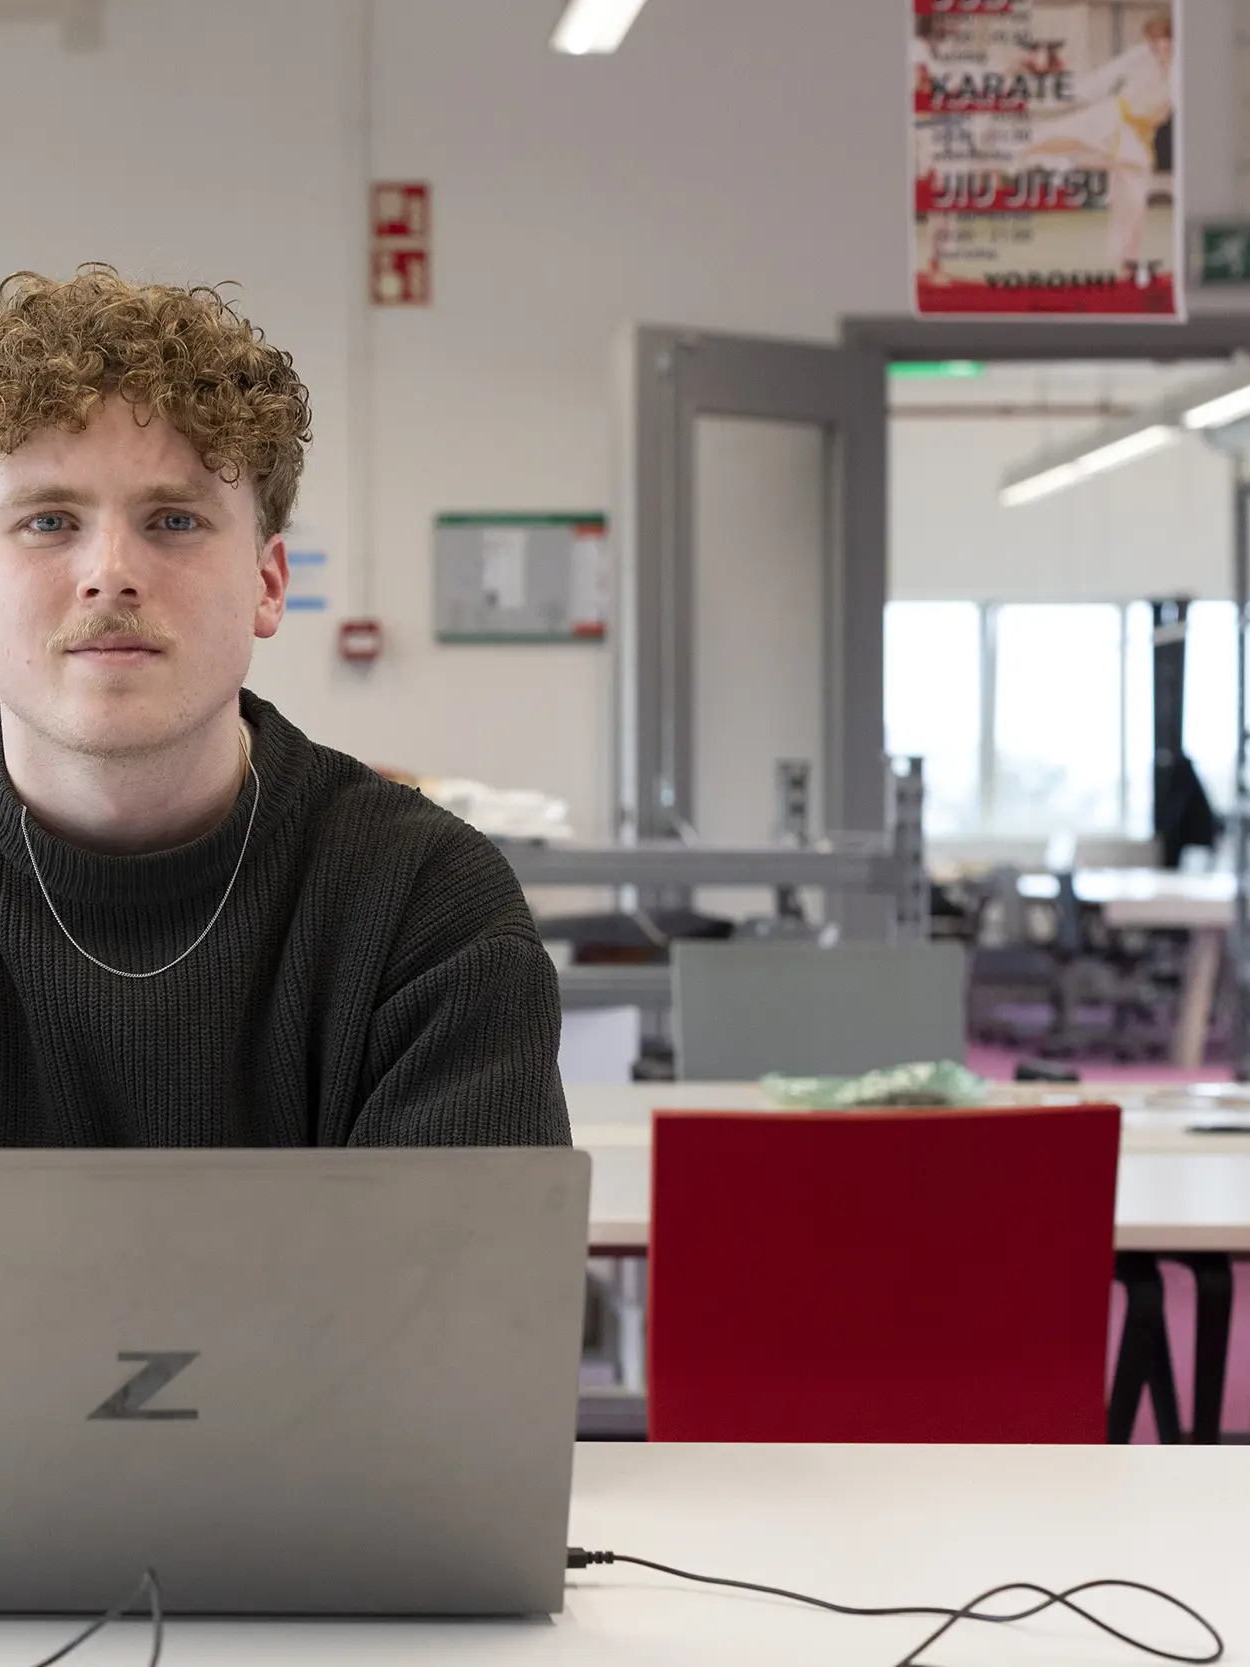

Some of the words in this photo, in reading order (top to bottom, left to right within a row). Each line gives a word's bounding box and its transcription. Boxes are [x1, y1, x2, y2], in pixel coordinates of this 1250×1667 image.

[930, 71, 1075, 101] KARATE
[935, 169, 997, 208] JIU
[1005, 168, 1111, 208] JITSU
